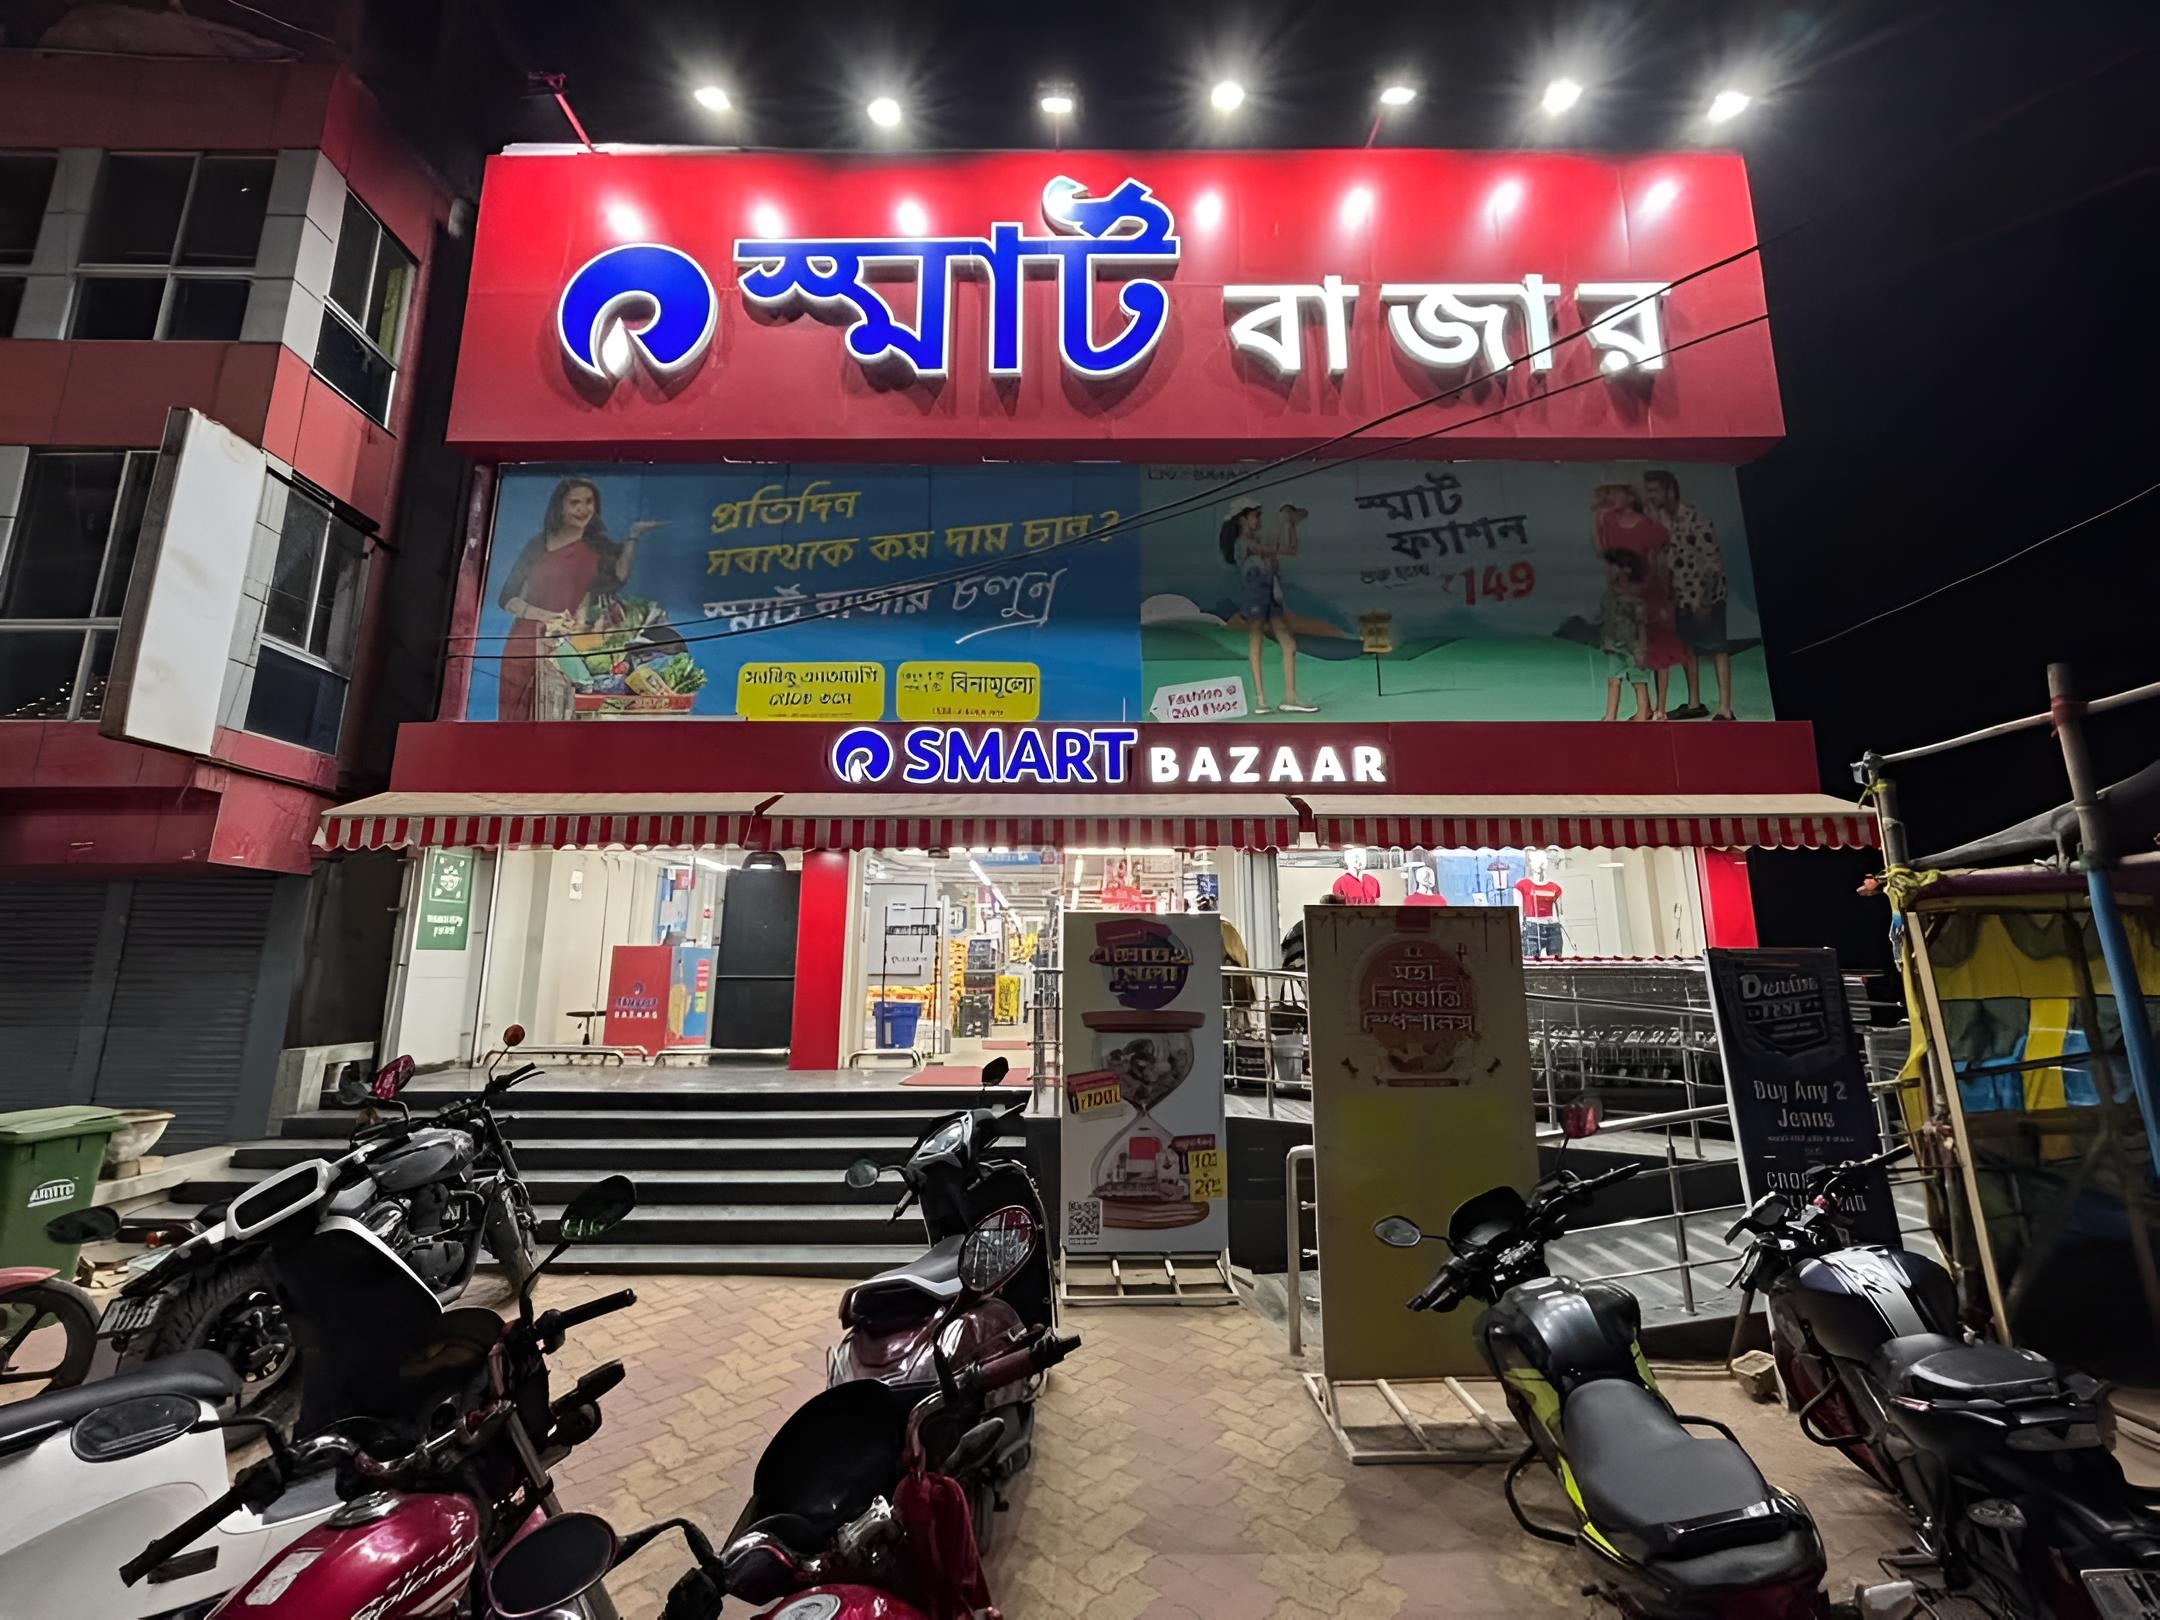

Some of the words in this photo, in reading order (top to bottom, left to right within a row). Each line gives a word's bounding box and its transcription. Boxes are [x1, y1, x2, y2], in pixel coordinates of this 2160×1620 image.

[733, 175, 1181, 379] স্মার্ট
[1222, 273, 1672, 376] বাজার
[711, 481, 862, 533] প্রতিদিন
[1355, 472, 1462, 520] স্মার্ট
[868, 531, 935, 561] কম
[945, 523, 1012, 557] দাম
[1387, 515, 1527, 559] ফ্যাশন
[903, 728, 1138, 784] SMART
[1150, 745, 1387, 784] BAZAAR
[1833, 1081, 1847, 1100] 2
